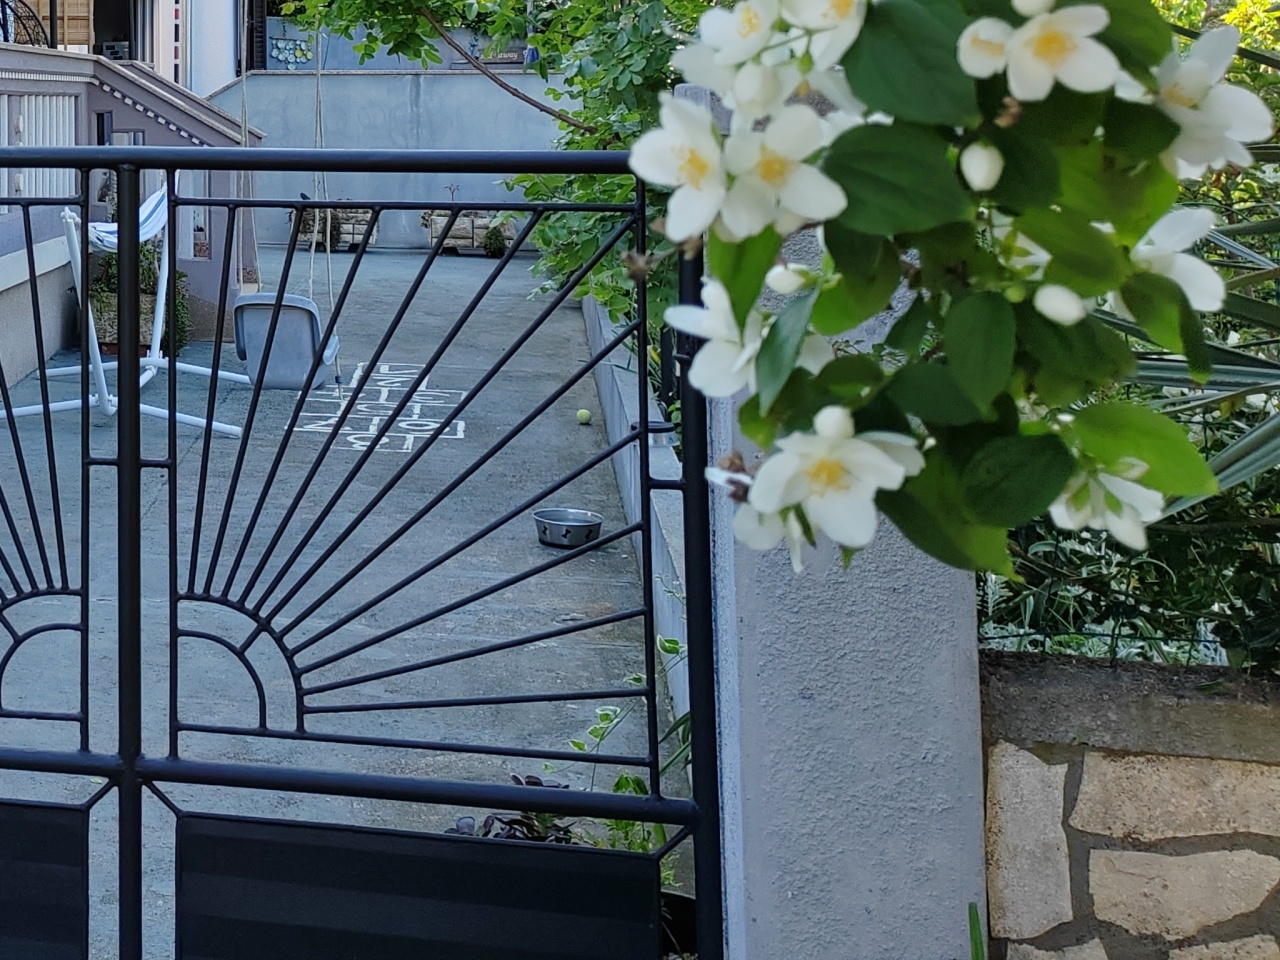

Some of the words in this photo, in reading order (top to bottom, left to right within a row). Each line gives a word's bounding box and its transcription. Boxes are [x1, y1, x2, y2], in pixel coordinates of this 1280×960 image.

[372, 376, 412, 387] 2
[412, 391, 451, 403] 3
[346, 434, 390, 449] 8
